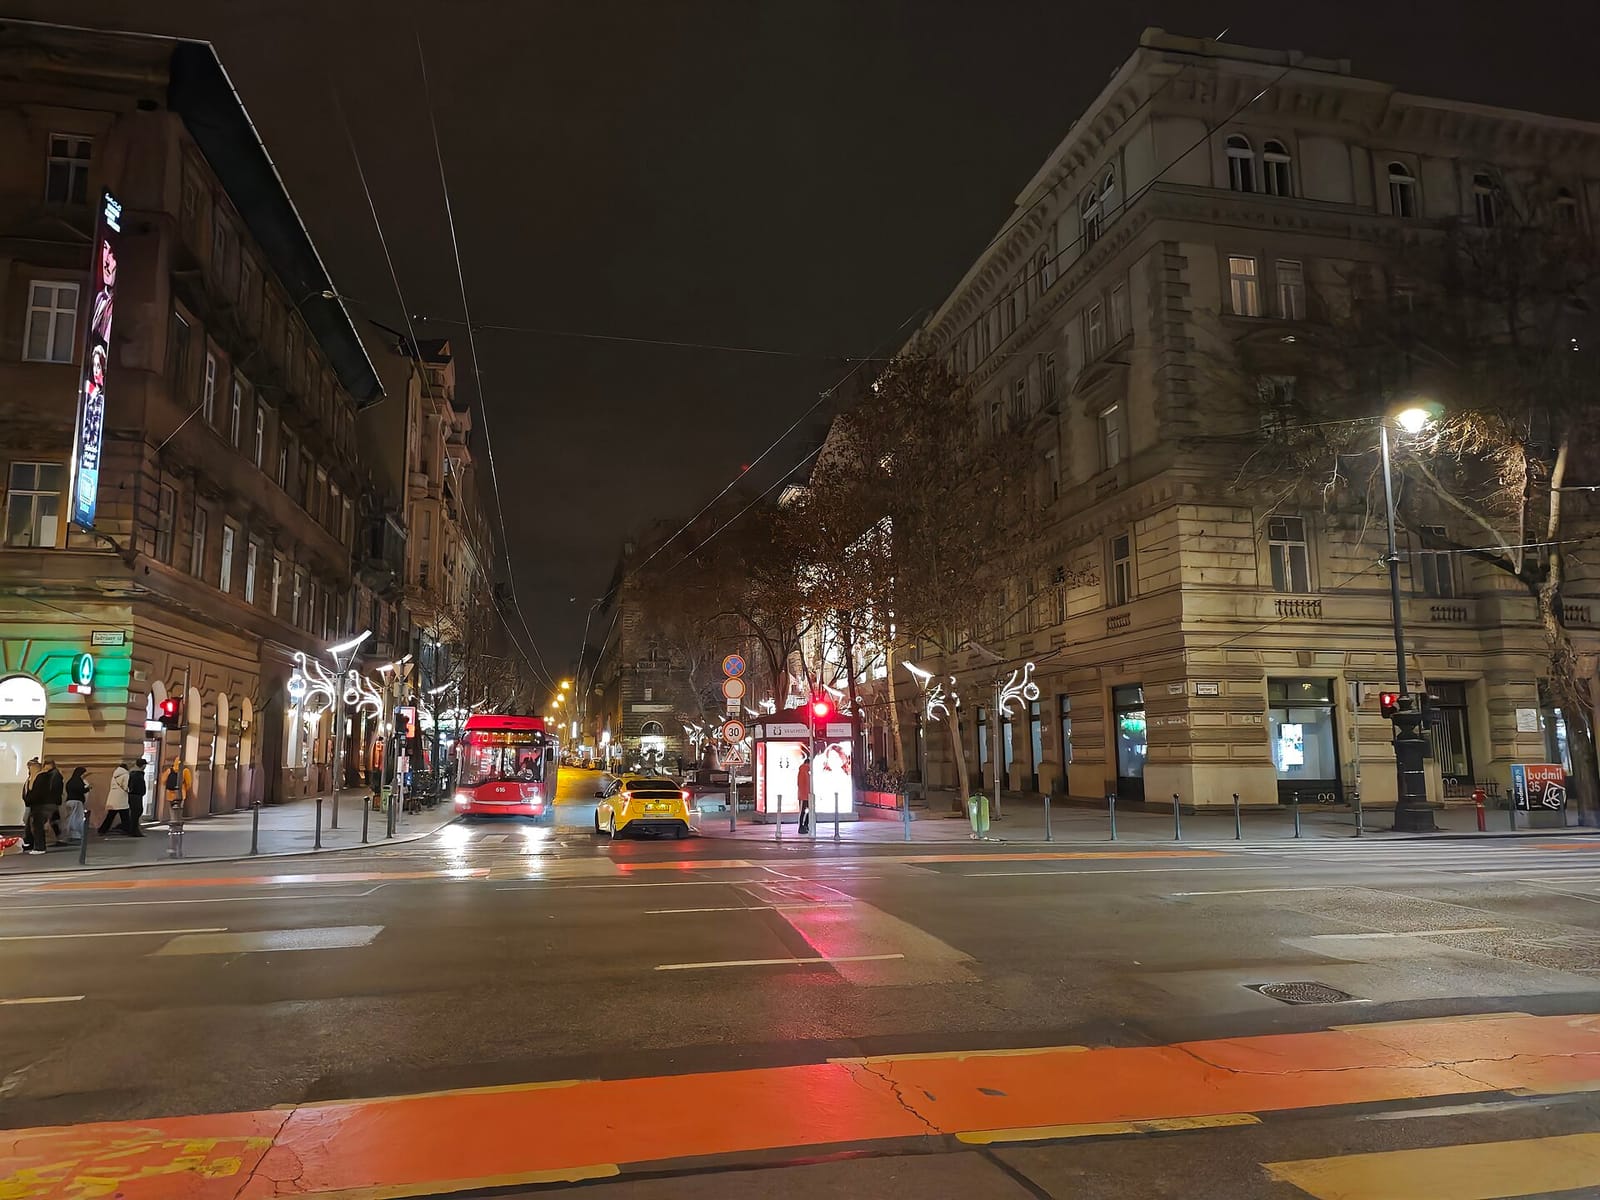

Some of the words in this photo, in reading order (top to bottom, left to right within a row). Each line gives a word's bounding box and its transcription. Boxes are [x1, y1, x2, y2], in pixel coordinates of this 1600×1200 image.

[728, 727, 740, 737] 30
[1528, 768, 1563, 780] budmil
[1529, 781, 1541, 792] 35
